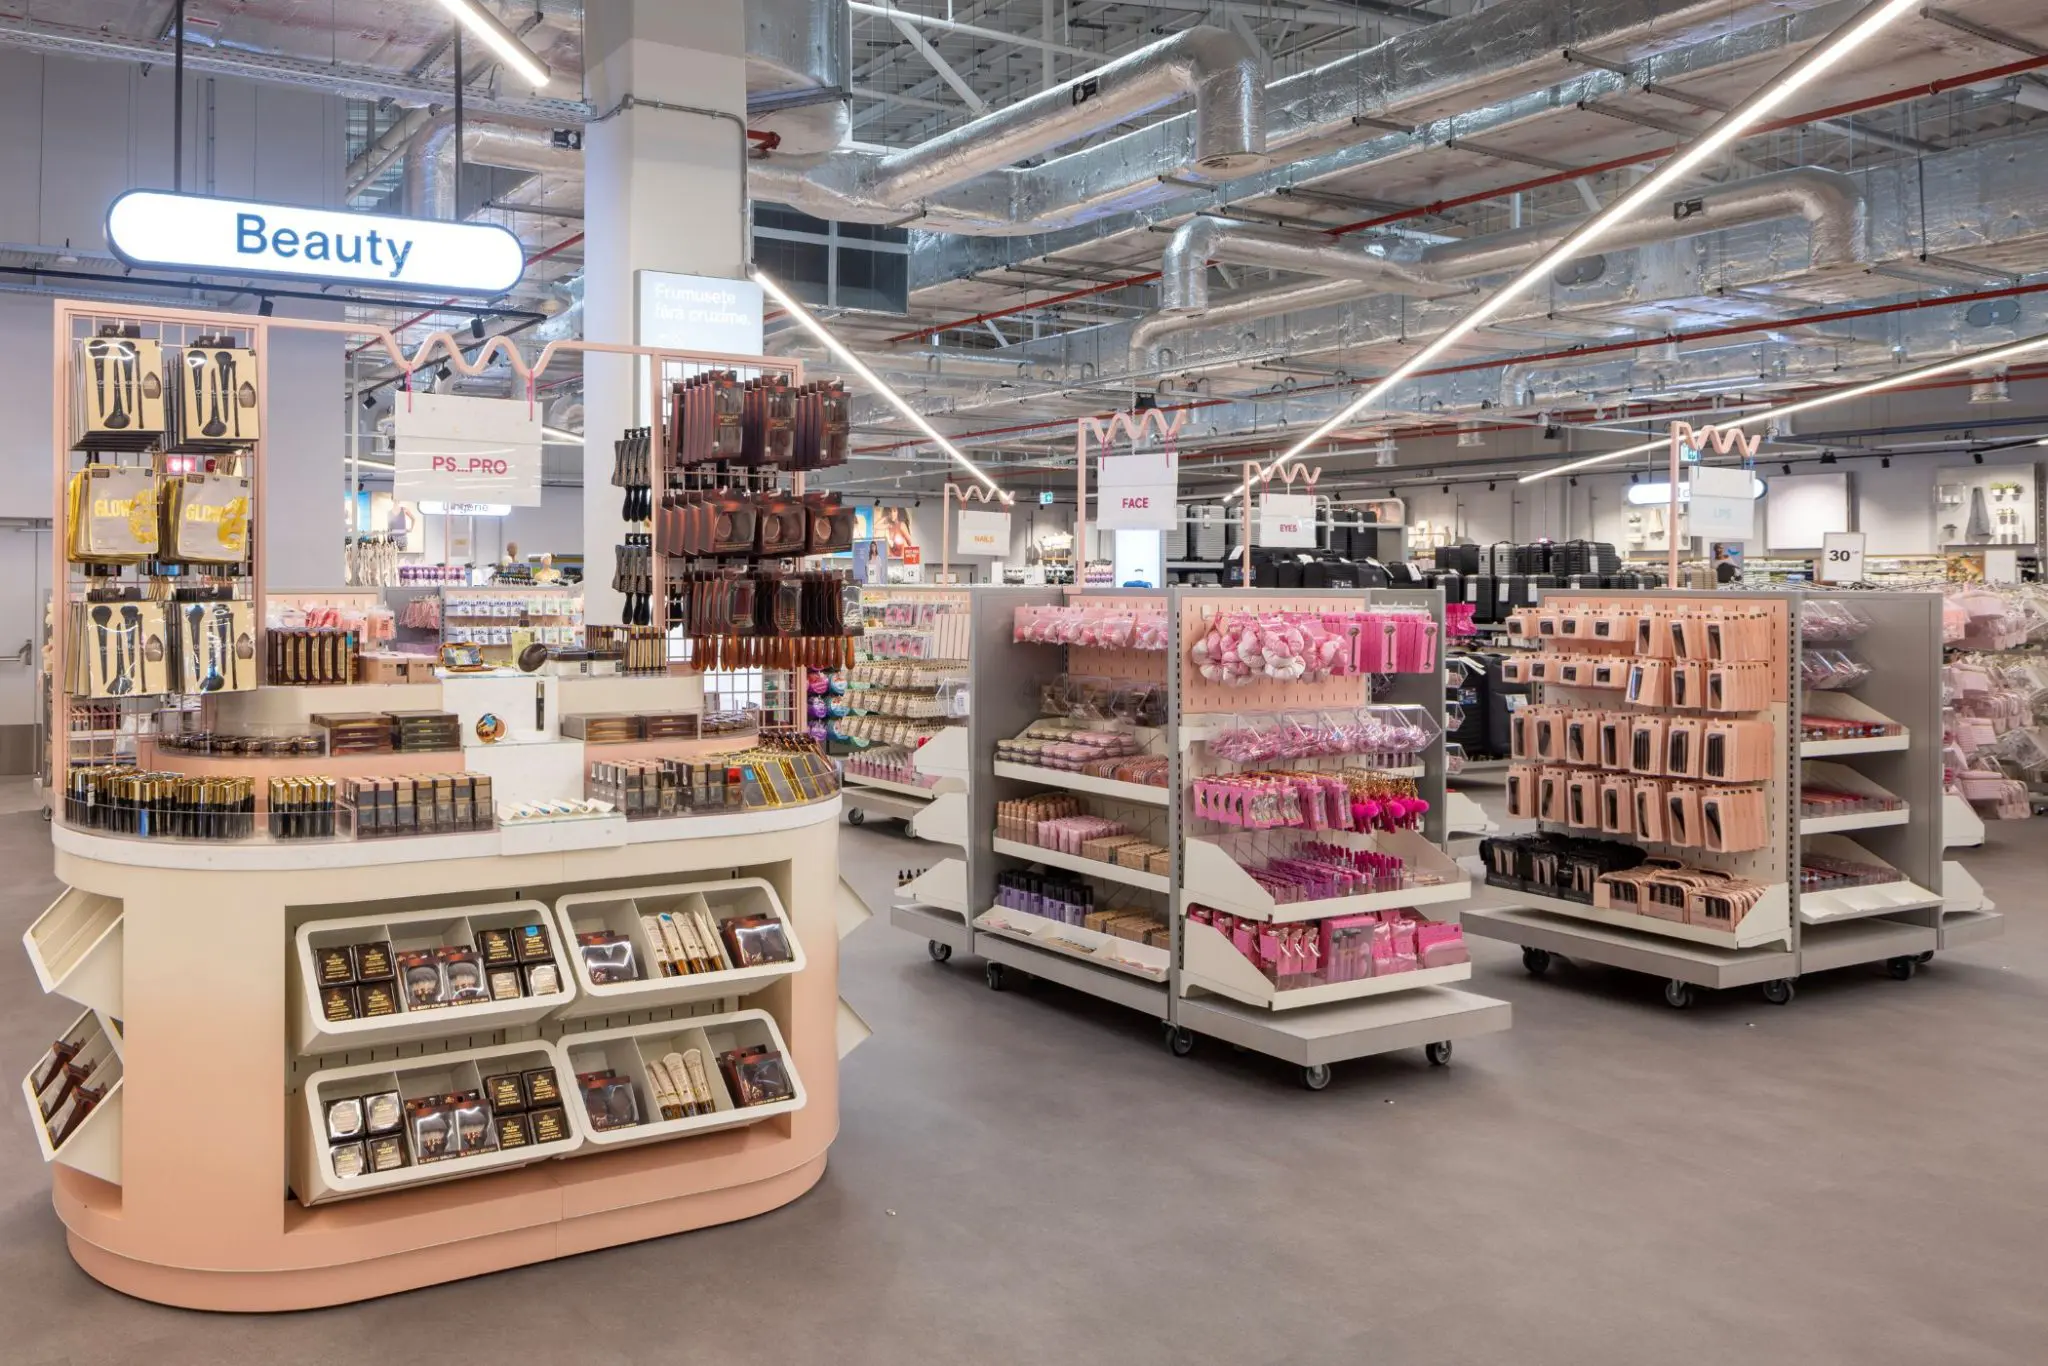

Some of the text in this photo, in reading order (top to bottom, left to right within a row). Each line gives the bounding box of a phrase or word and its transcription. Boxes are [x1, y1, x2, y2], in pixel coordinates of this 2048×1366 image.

[236, 212, 413, 277] Beauty
[94, 499, 132, 517] GLOW
[1122, 497, 1149, 509] FACE
[1279, 523, 1298, 533] EYES
[974, 535, 995, 543] NAILS
[1828, 549, 1851, 562] 30
